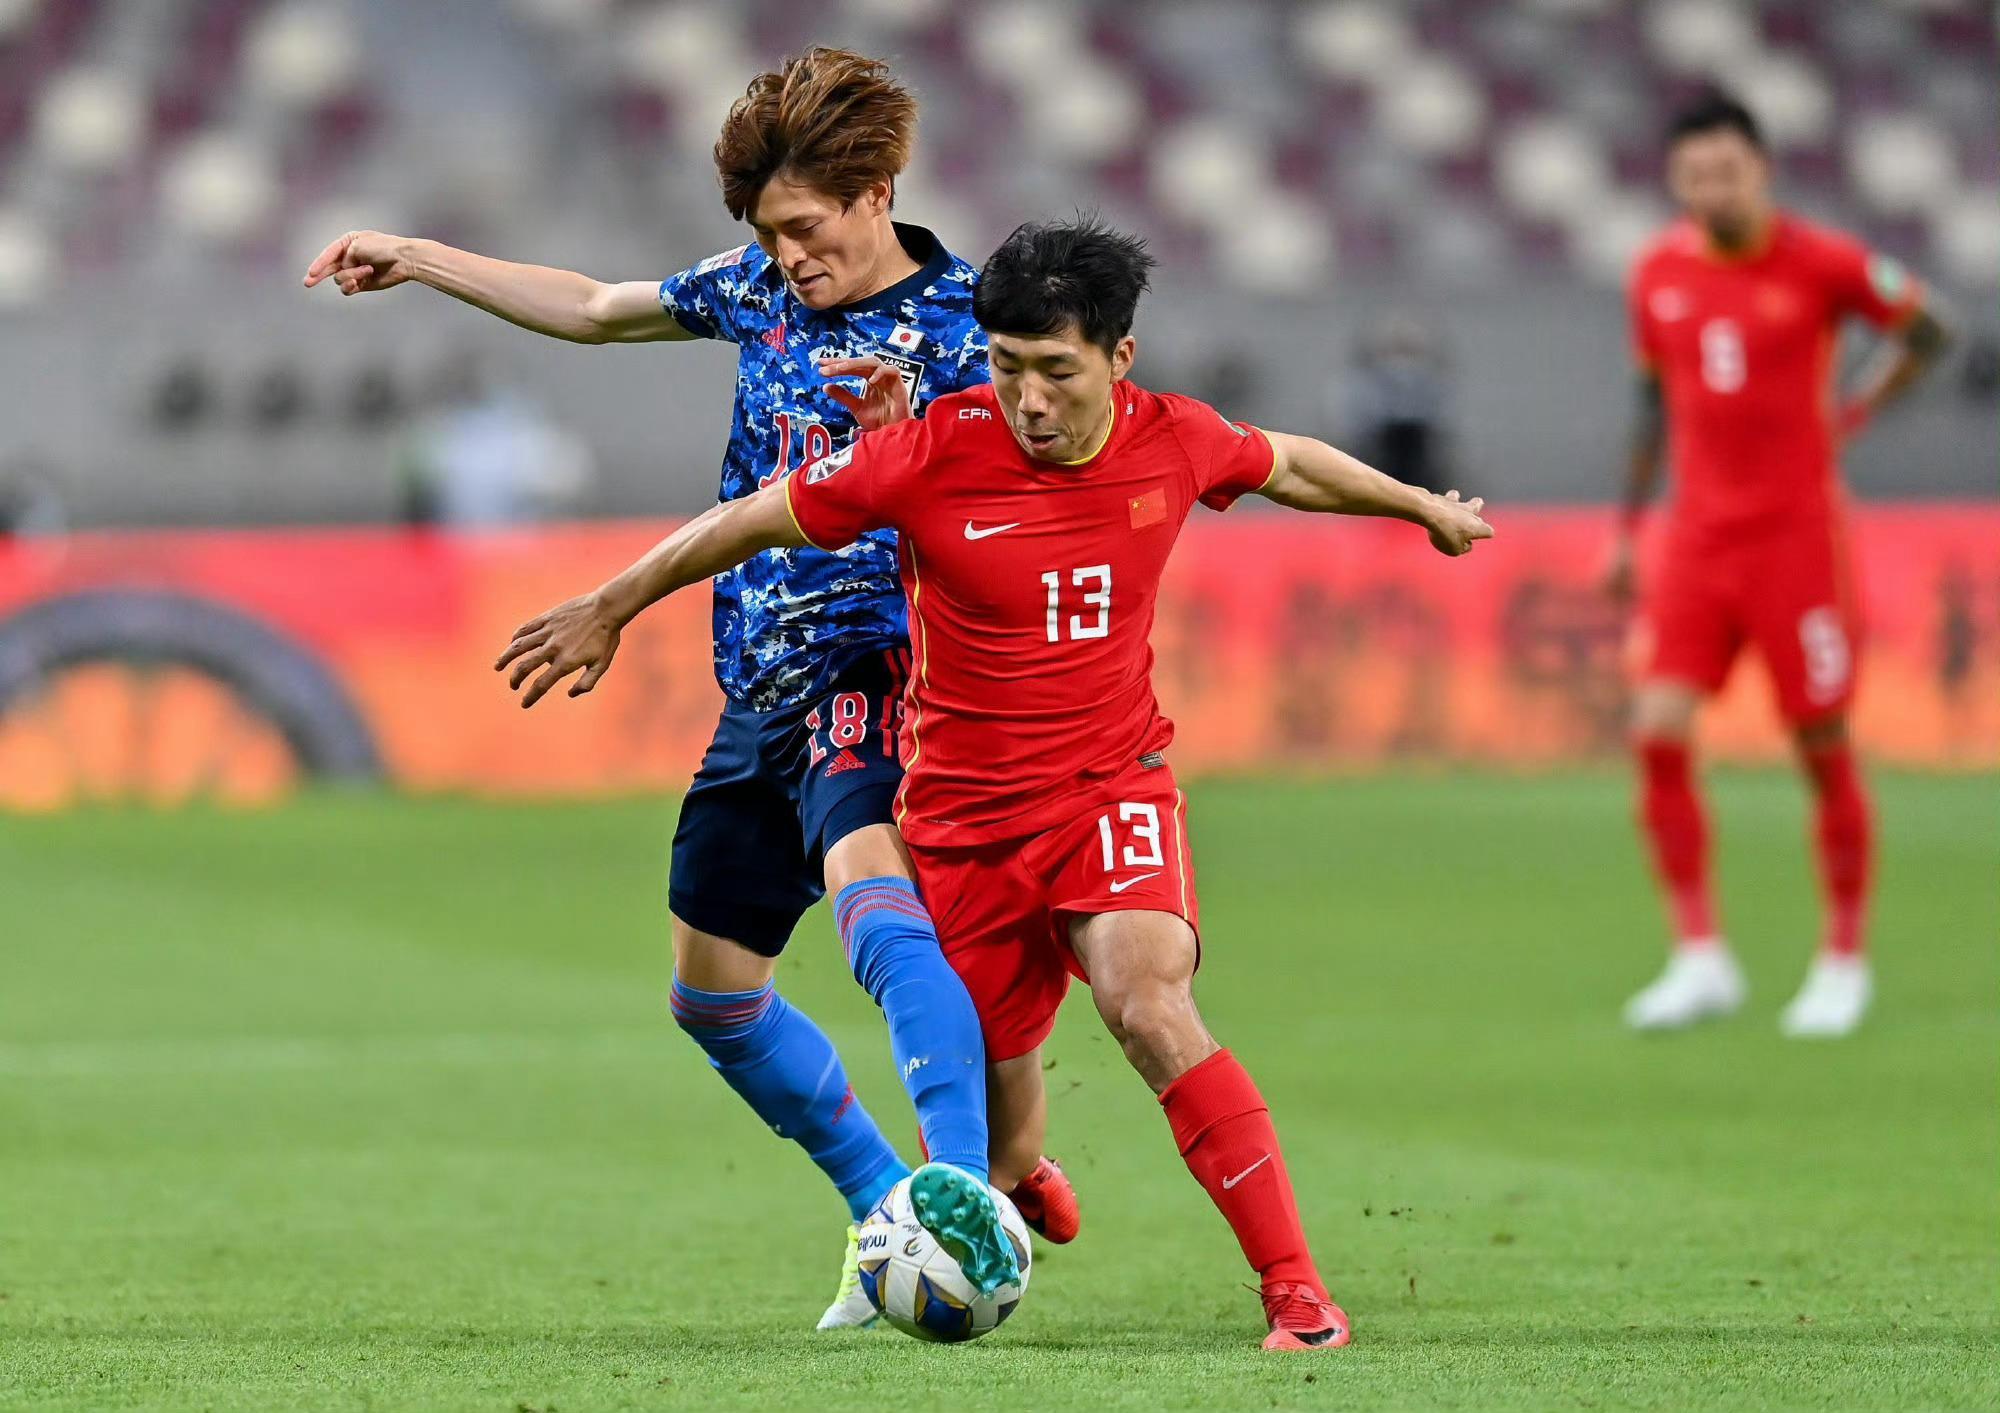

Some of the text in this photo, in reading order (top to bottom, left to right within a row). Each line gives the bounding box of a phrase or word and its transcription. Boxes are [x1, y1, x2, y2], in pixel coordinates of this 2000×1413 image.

[883, 357, 911, 370] JAPAN
[958, 407, 993, 421] CFA
[1041, 564, 1112, 643] 13
[805, 691, 868, 769] 18
[824, 760, 867, 778] adidas
[1098, 801, 1165, 872] 13
